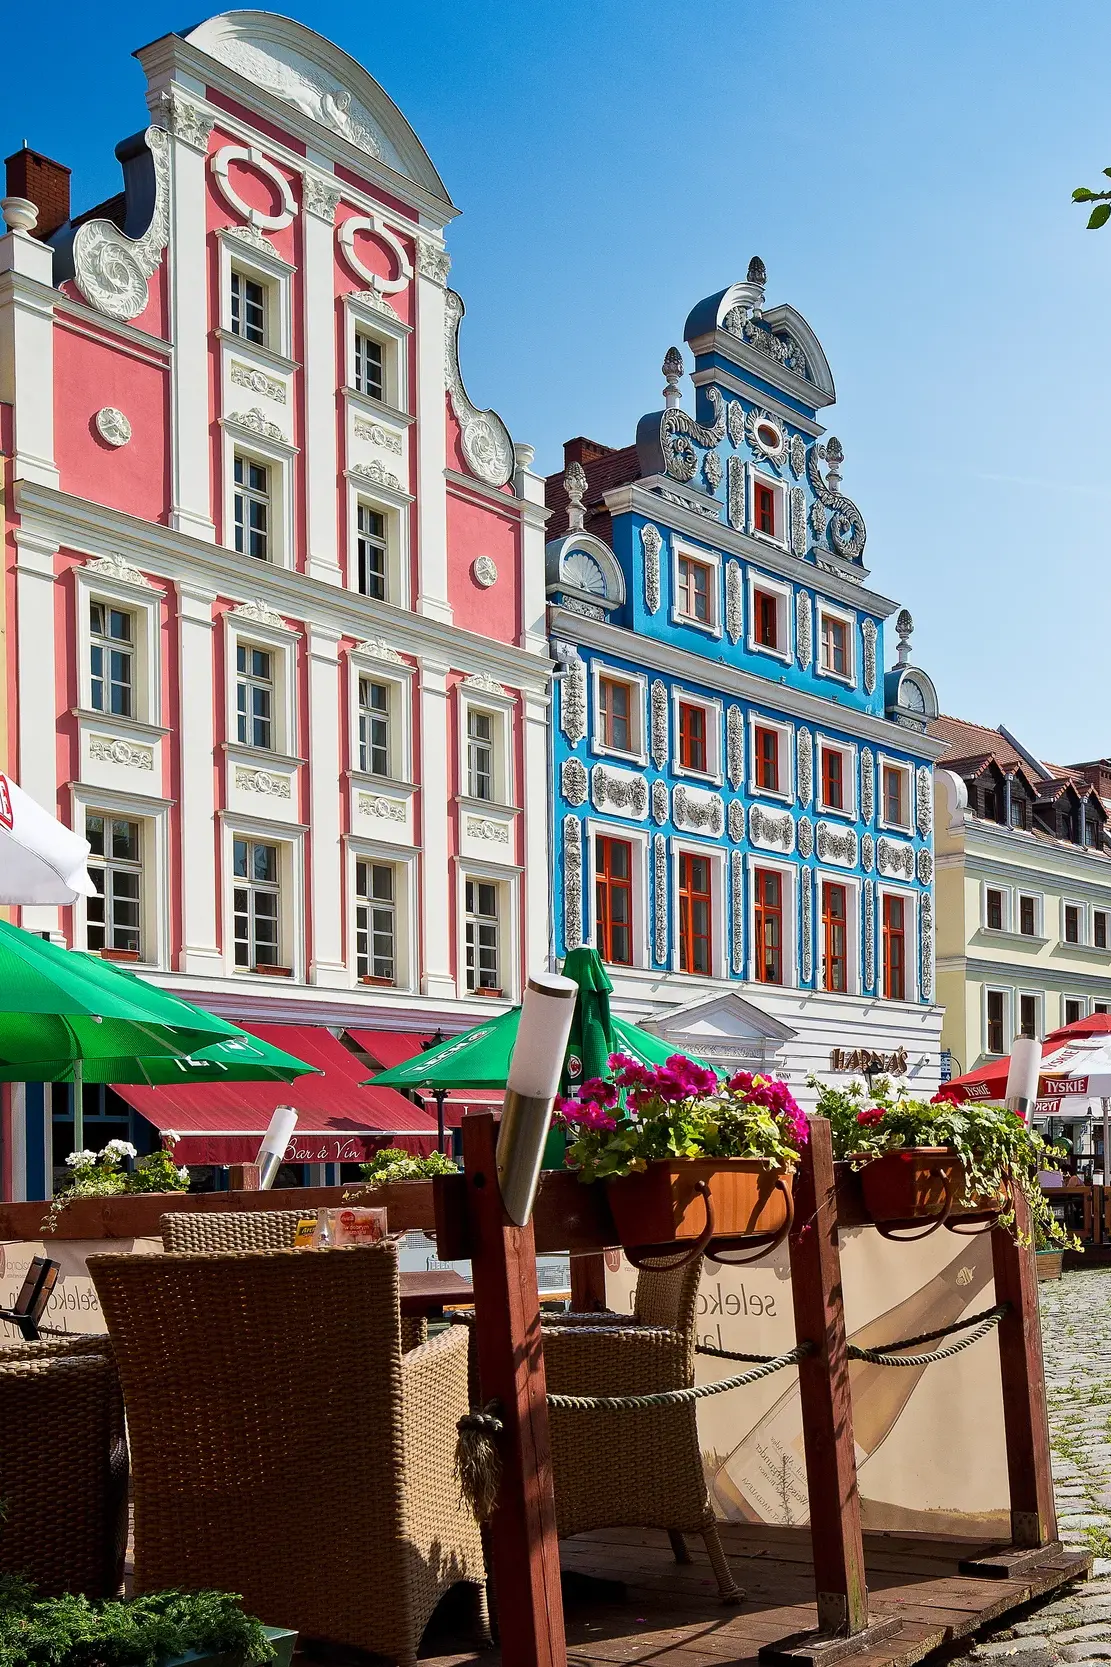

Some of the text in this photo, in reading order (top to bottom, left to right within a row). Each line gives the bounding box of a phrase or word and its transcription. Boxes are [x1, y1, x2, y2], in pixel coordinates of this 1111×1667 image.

[963, 1083, 991, 1096] TYSKIE
[1045, 1080, 1086, 1093] TYSKIE
[283, 1137, 314, 1161] Bar
[334, 1138, 361, 1159] Vin
